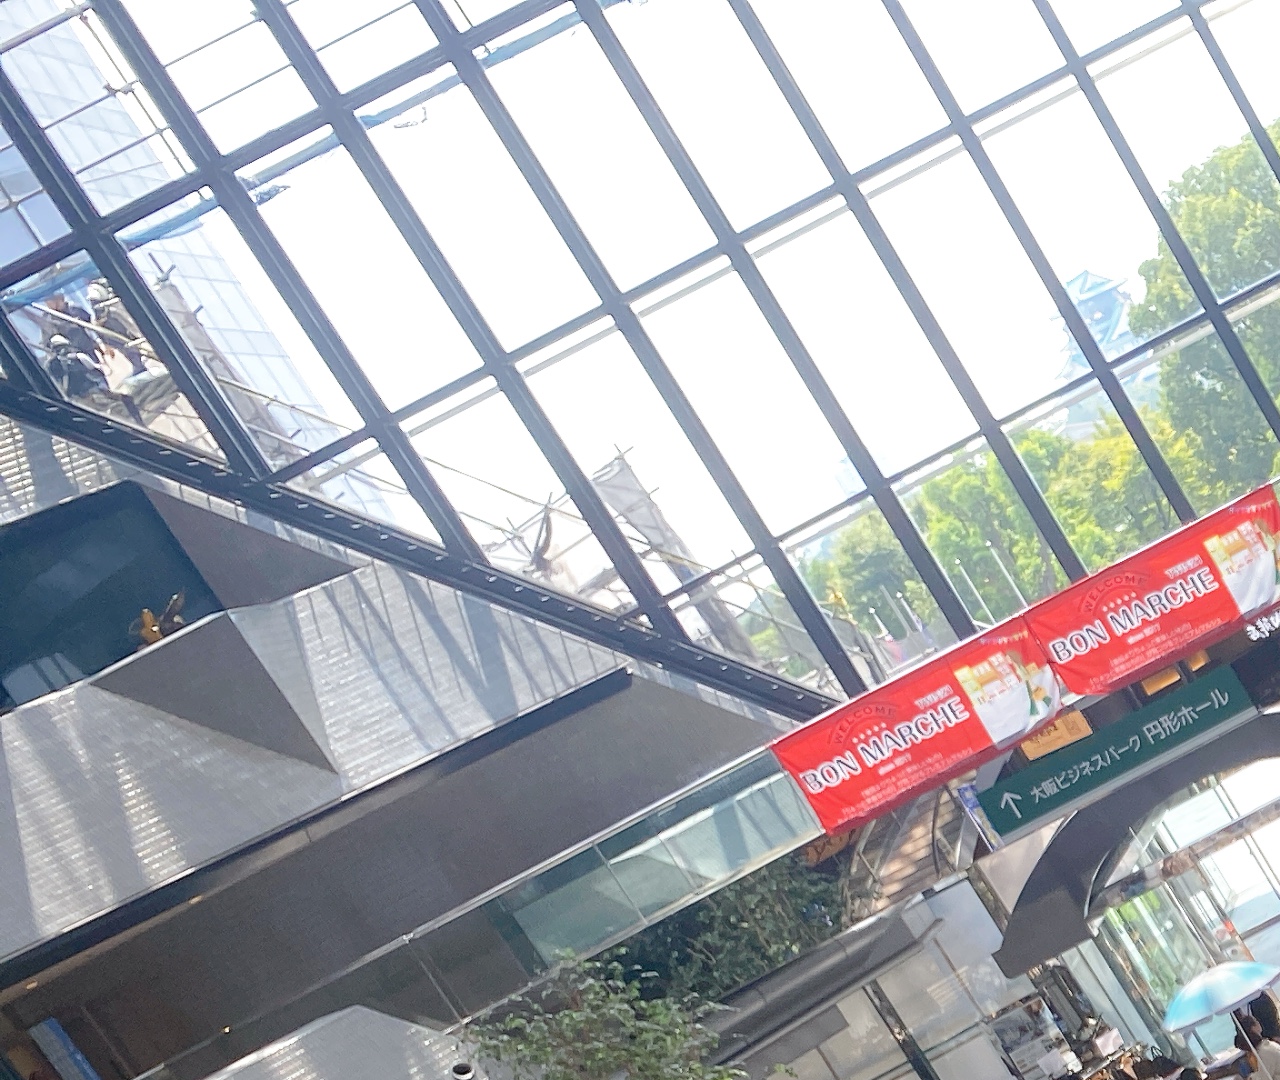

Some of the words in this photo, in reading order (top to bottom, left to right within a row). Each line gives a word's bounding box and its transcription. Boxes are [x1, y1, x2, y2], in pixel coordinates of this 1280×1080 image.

[1049, 620, 1110, 665] BON
[1107, 568, 1220, 637] MARCHE
[1082, 574, 1145, 611] WELCOME
[801, 751, 862, 797] BON
[857, 698, 970, 767] MARCHE
[833, 705, 896, 744] WELCOME
[1029, 736, 1143, 803] 大阪ビジネスパーク
[1143, 689, 1230, 744] 円形ホール
